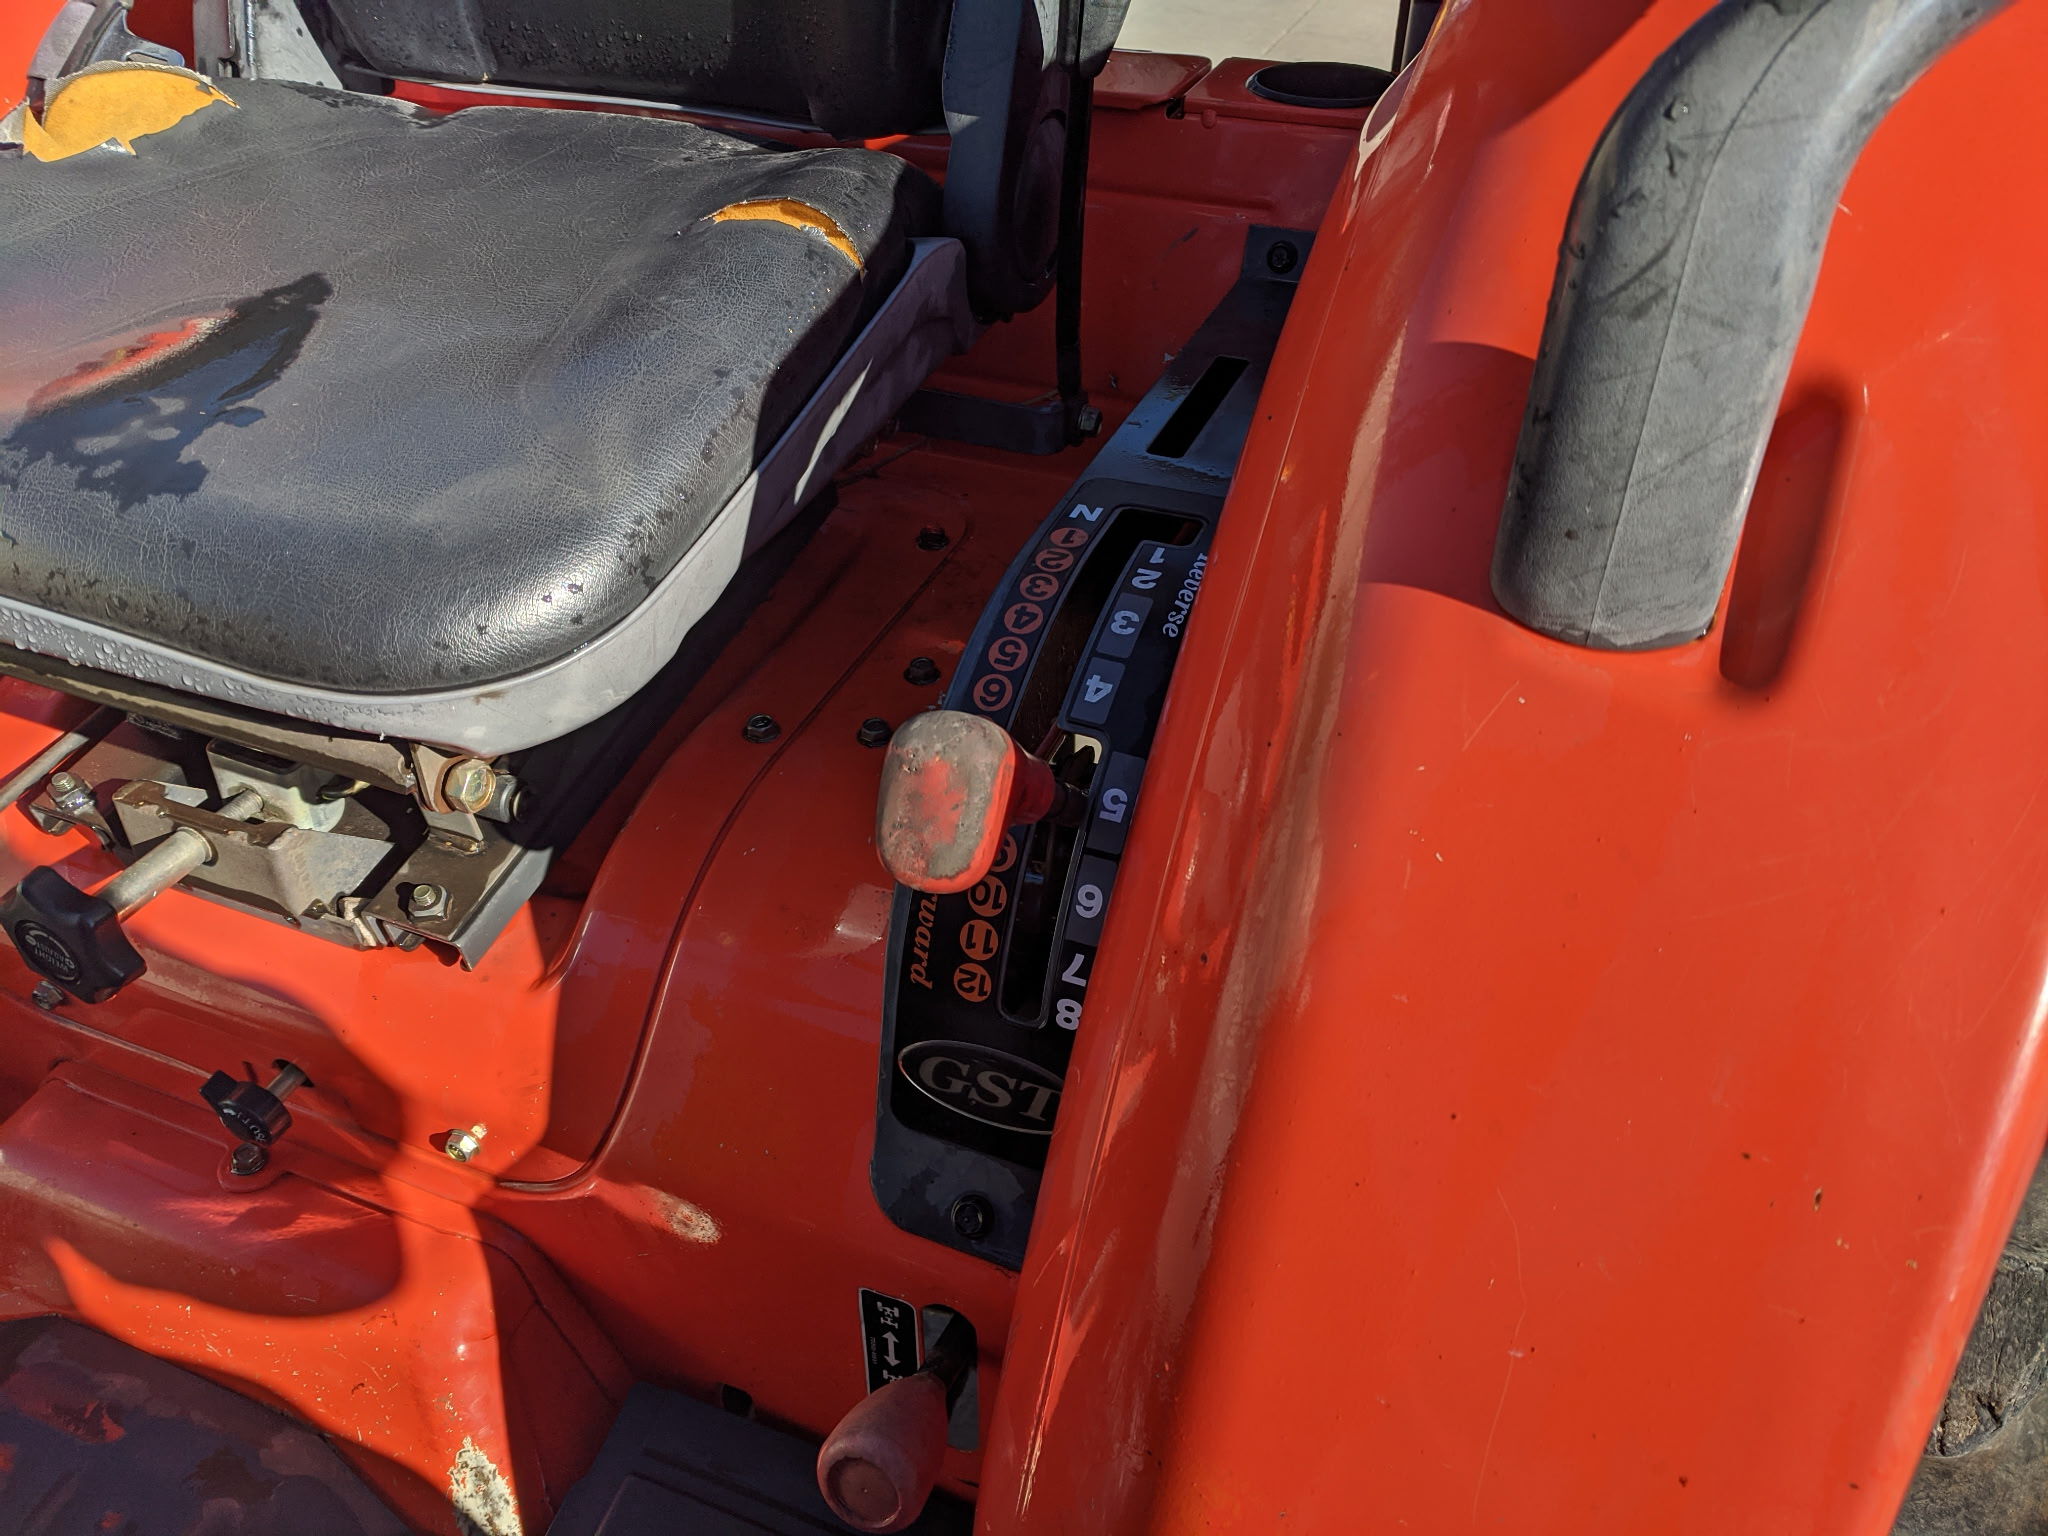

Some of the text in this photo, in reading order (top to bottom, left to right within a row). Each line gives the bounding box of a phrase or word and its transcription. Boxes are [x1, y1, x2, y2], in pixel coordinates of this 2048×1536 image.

[1069, 504, 1104, 521] N
[1061, 529, 1076, 544] 1
[1041, 551, 1069, 569] 2
[1149, 547, 1165, 563] 1
[1025, 576, 1052, 597] 3
[1132, 568, 1162, 589] 2
[1012, 605, 1038, 629] 4
[1110, 610, 1139, 635] 3
[994, 640, 1021, 667] 5
[980, 678, 1005, 706] 6
[1084, 674, 1113, 703] 4
[1100, 788, 1128, 823] 5
[970, 881, 1003, 910] 10
[1076, 884, 1103, 918] 6
[965, 924, 993, 954] 11
[957, 968, 988, 996] 12
[1061, 953, 1087, 987] 7
[1055, 998, 1083, 1031] 8
[919, 1056, 1063, 1121] GST
